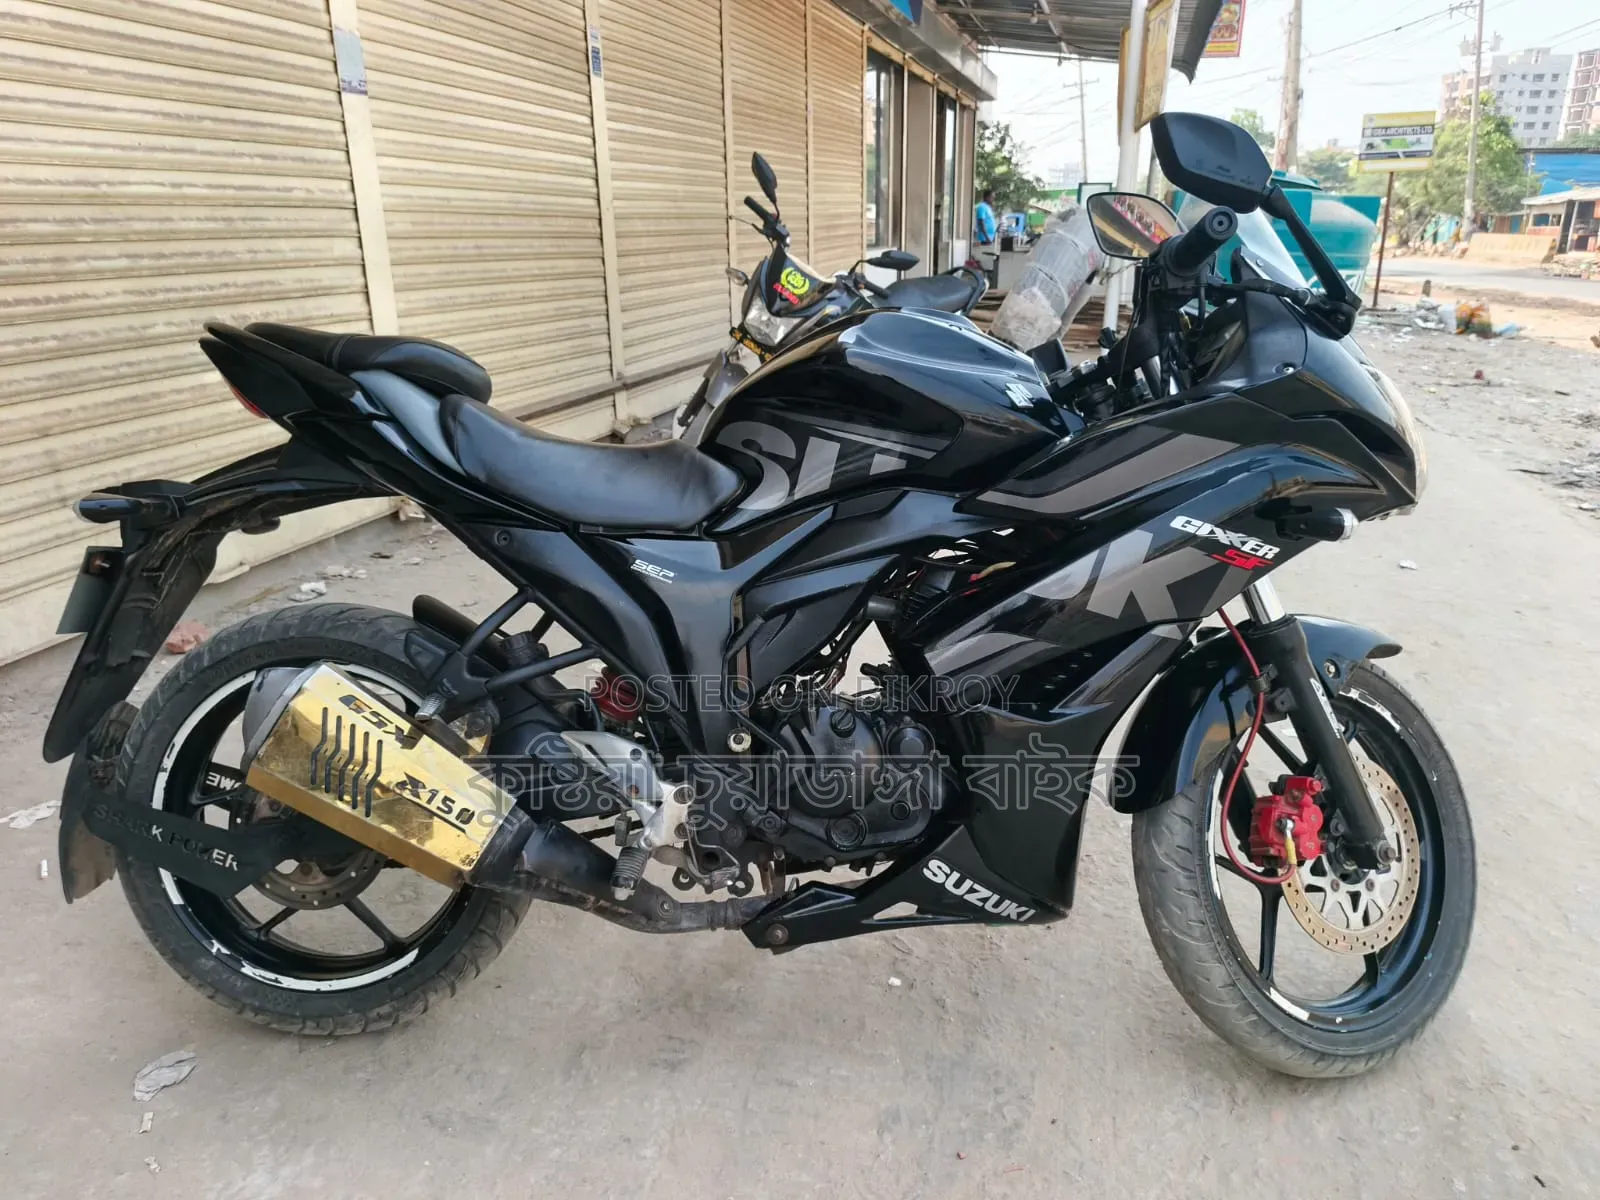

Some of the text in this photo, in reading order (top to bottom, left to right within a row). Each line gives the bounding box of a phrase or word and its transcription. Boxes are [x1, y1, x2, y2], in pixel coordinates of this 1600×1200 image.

[1169, 515, 1281, 559] GIXXER
[631, 559, 676, 578] SEP
[1210, 548, 1274, 571] SF
[338, 694, 419, 749] GSX
[168, 832, 239, 872] POWER
[922, 859, 1036, 922] SUZUKI
